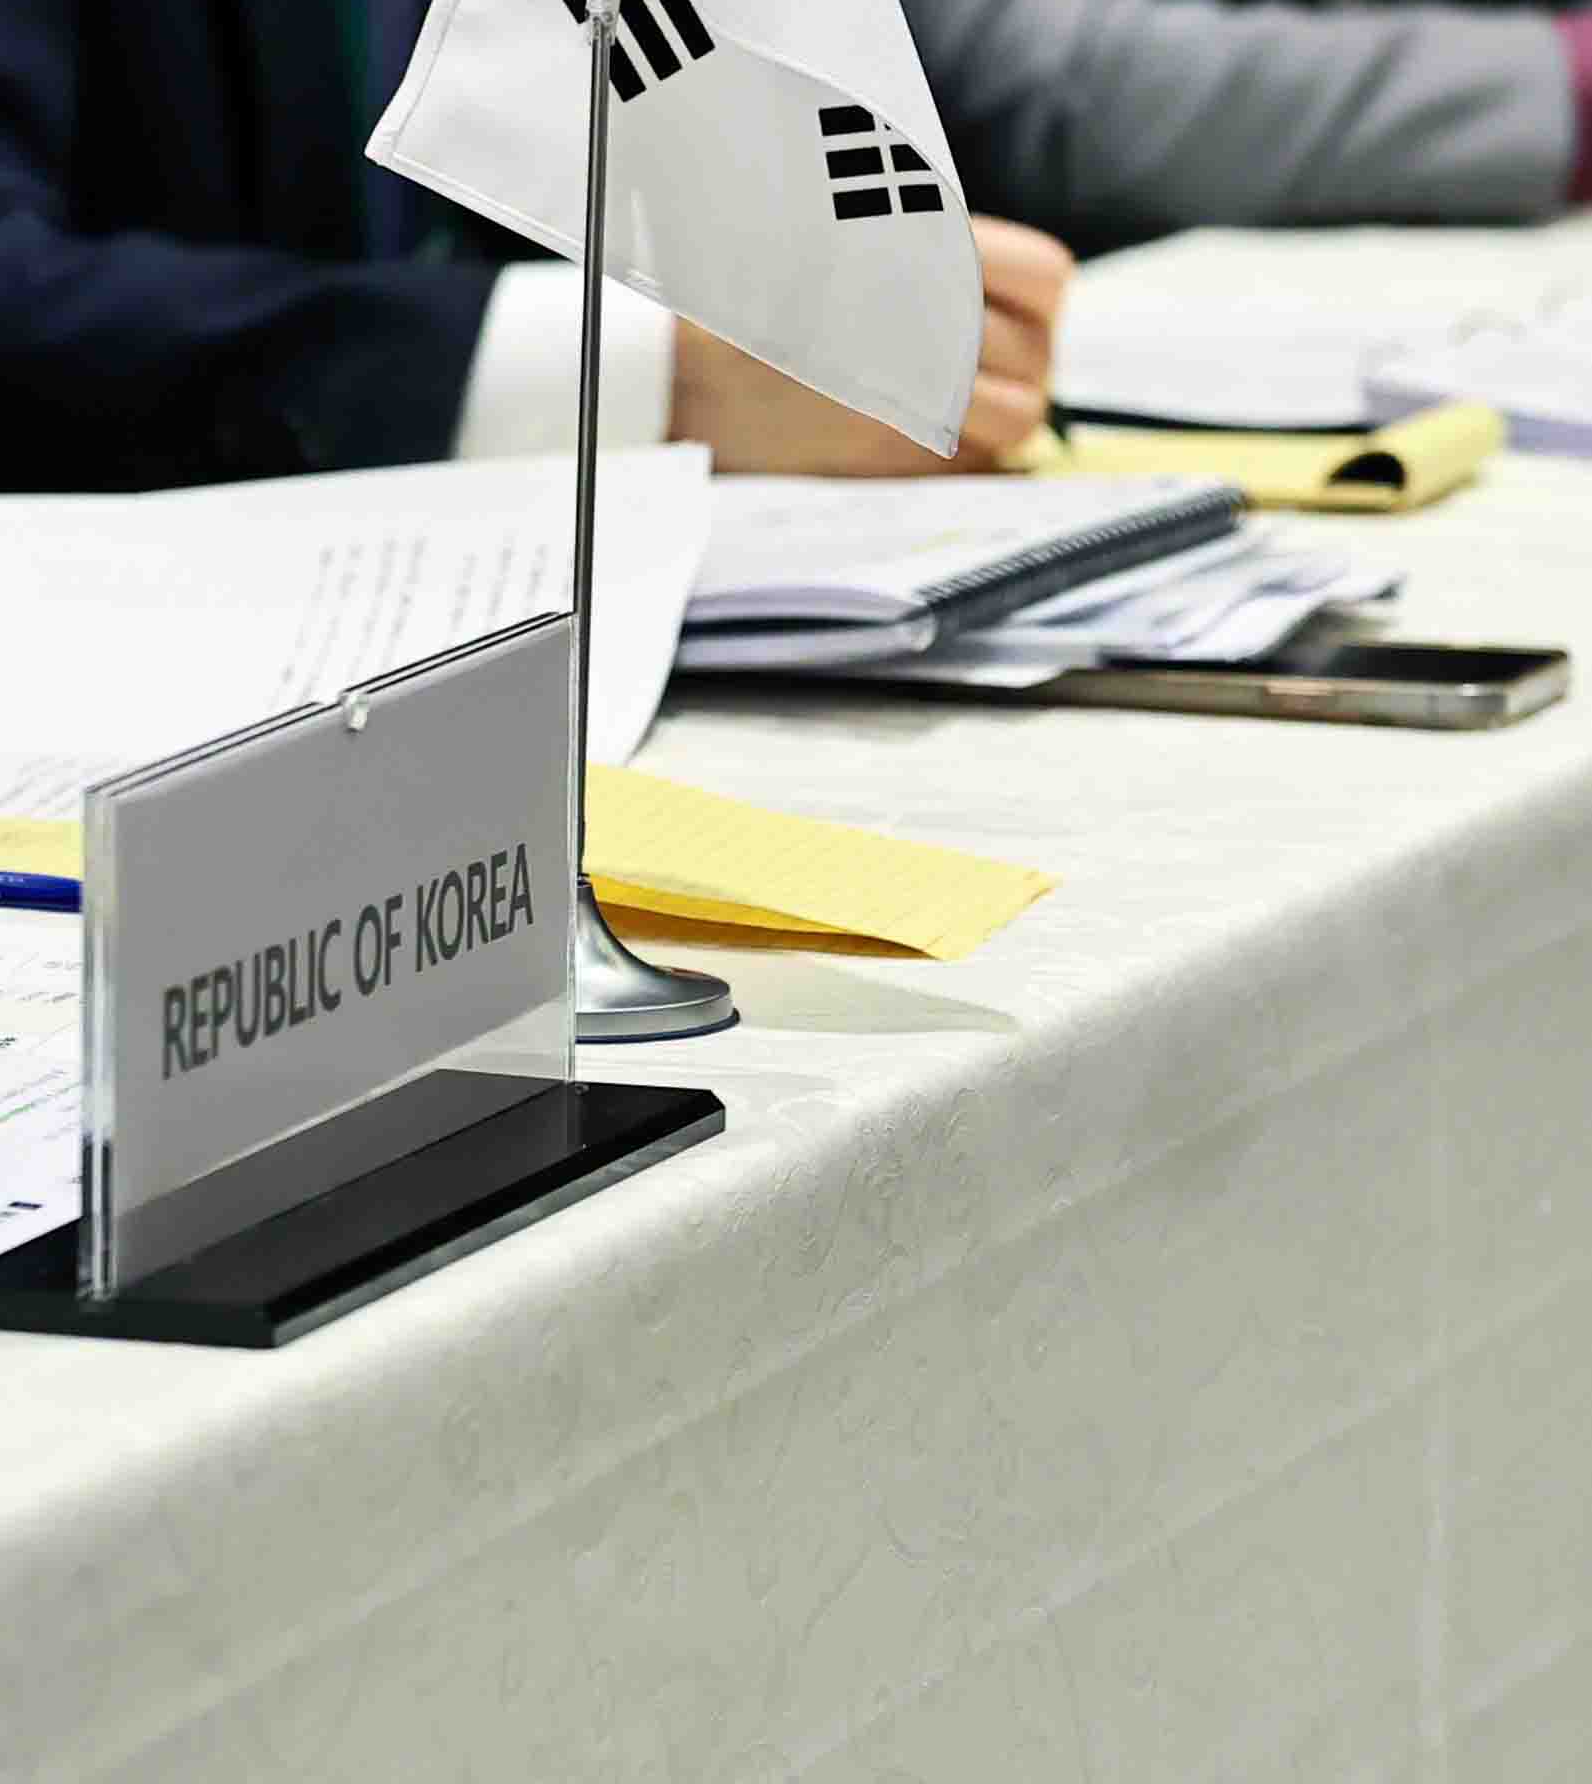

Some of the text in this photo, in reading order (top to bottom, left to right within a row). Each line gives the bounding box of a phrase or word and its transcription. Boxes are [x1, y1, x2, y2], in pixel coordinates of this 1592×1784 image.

[162, 918, 342, 1080] REPUBLIC
[353, 893, 403, 997] OF
[416, 842, 534, 973] KOREA
